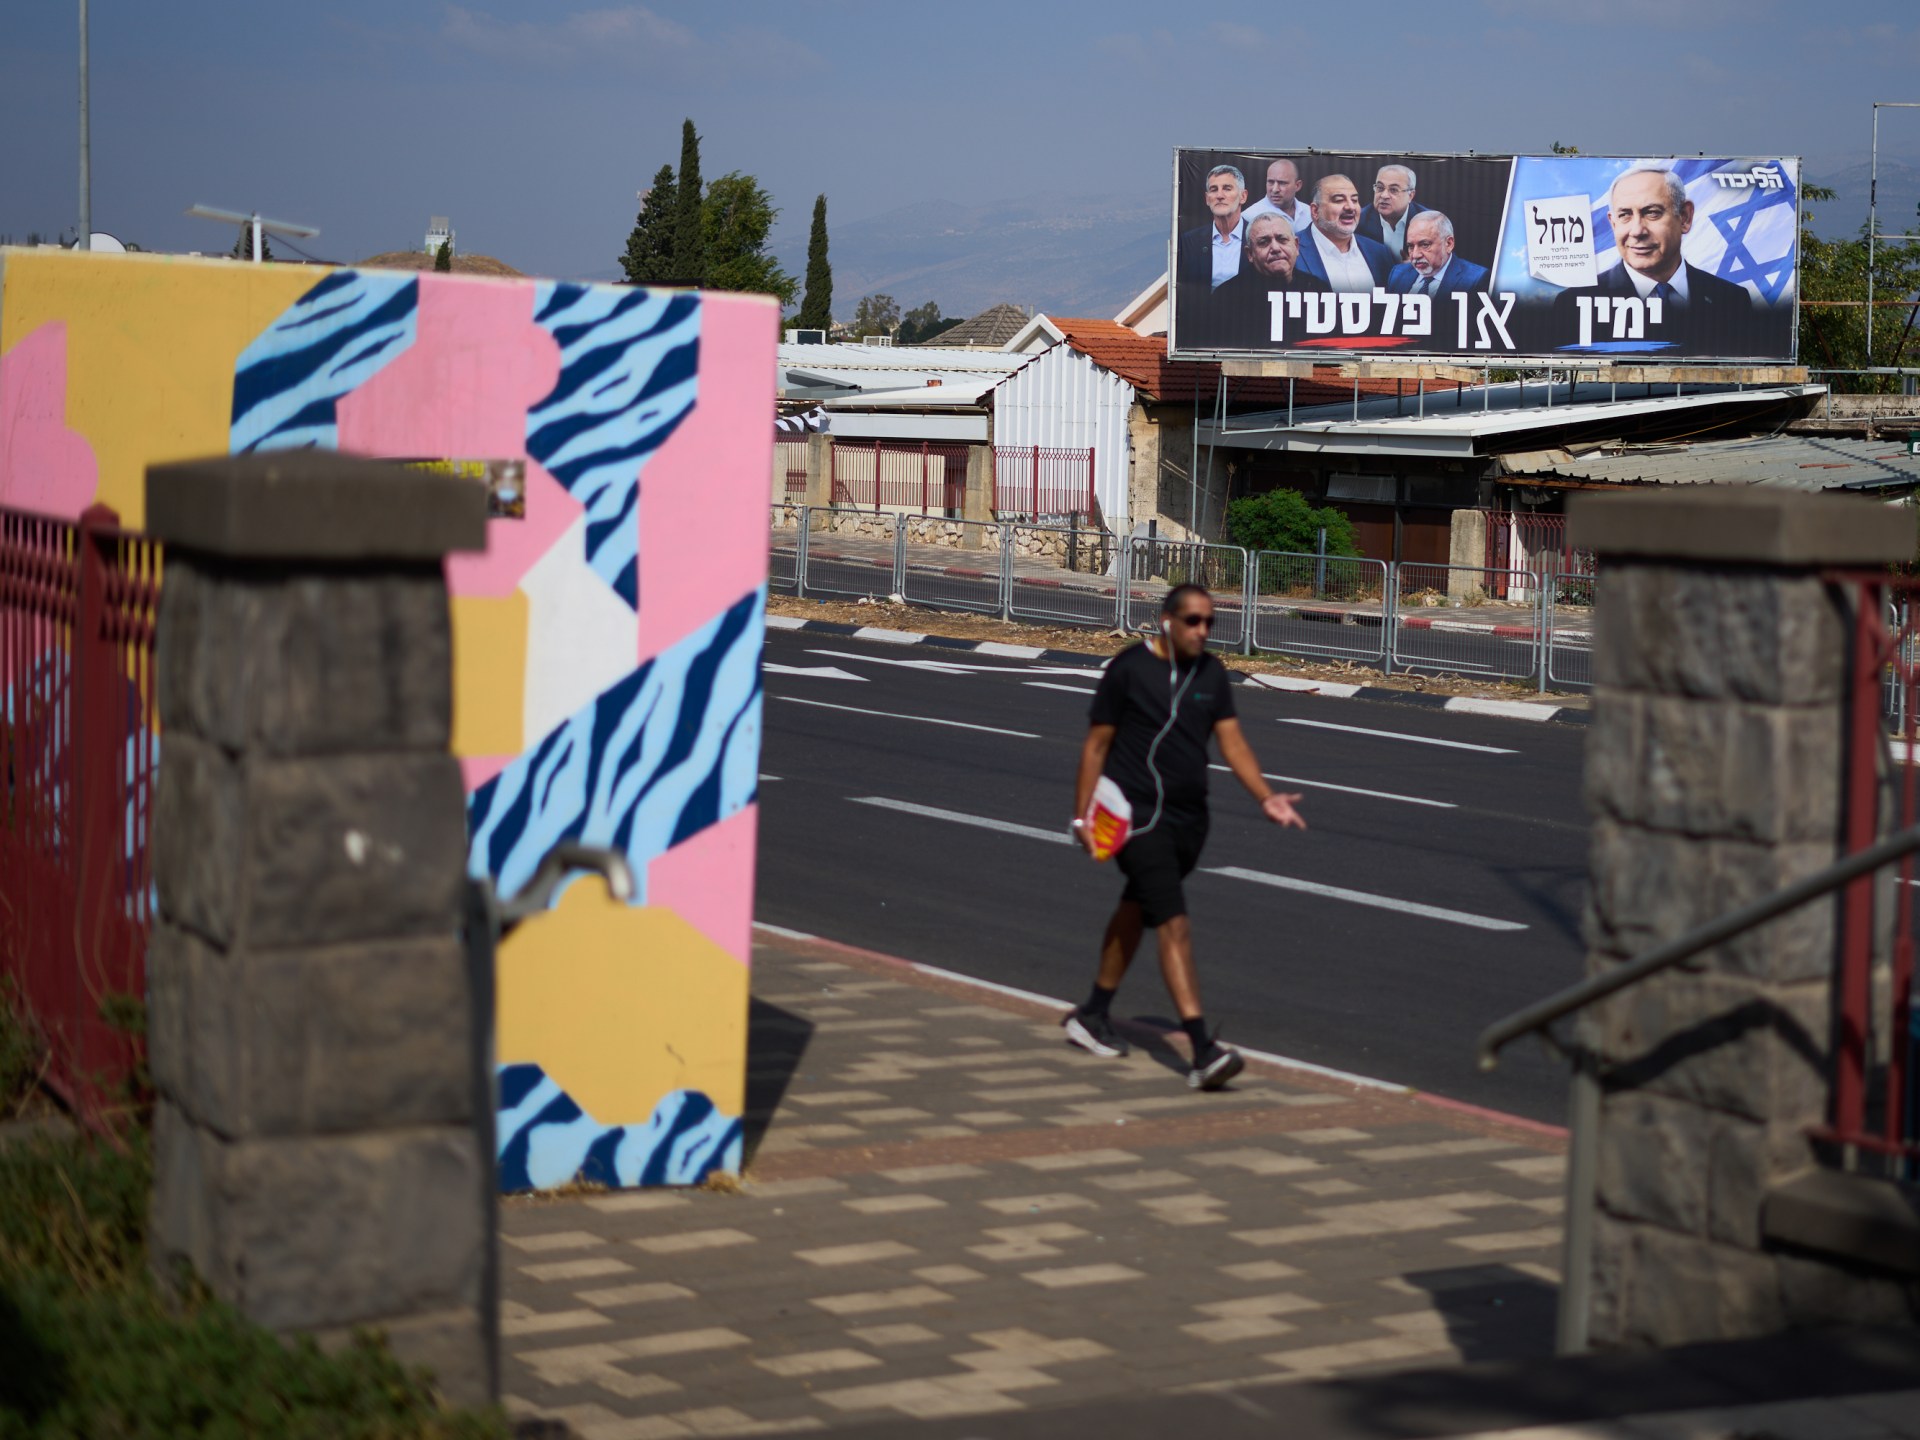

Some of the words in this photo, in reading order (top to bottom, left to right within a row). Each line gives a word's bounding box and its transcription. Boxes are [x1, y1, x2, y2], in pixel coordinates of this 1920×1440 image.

[1711, 166, 1784, 188] הליכוד
[1532, 205, 1585, 245] מחל
[1268, 286, 1432, 342] פלסטין
[1451, 291, 1516, 349] או
[1576, 296, 1662, 347] ימין
